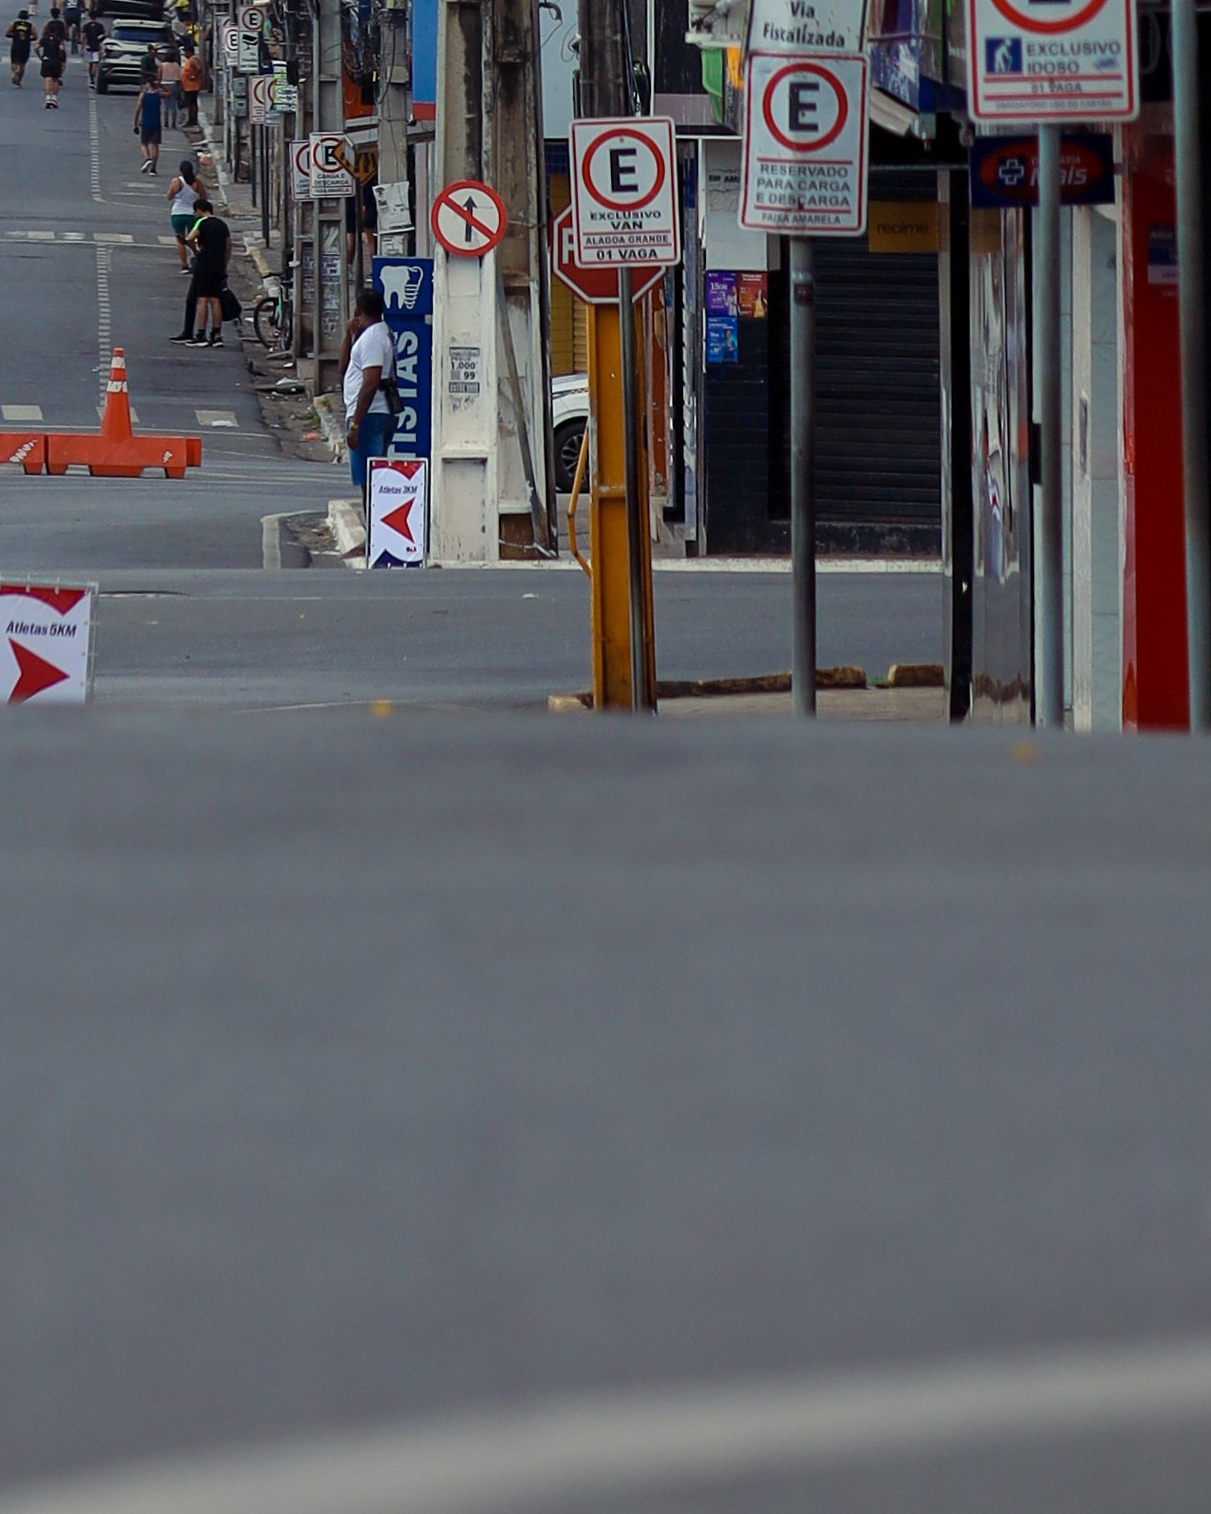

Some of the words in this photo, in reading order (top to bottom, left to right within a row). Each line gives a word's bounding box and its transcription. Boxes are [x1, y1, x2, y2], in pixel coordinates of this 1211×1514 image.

[790, 0, 815, 19] Via
[763, 22, 845, 48] Fiscalizada
[1027, 40, 1121, 57] EXCLUSIVO
[1027, 60, 1080, 75] IDOSO
[788, 82, 819, 133] E
[609, 148, 638, 193] E
[760, 164, 849, 178] RESERVADO
[756, 178, 794, 191] PARA
[798, 179, 851, 192] CARGA
[756, 192, 764, 204] E
[768, 193, 850, 207] DESCARGA
[590, 210, 661, 221] EXCLUSIVO
[761, 212, 789, 223] FAIXA
[792, 213, 841, 225] AMARELA
[611, 221, 643, 230] VAN
[586, 236, 626, 245] ALAGOA
[628, 235, 668, 244] GRANDE
[596, 250, 612, 260] 01
[618, 249, 658, 260] VAGA
[6, 621, 48, 636] Atletas
[49, 624, 77, 637] 5KM
